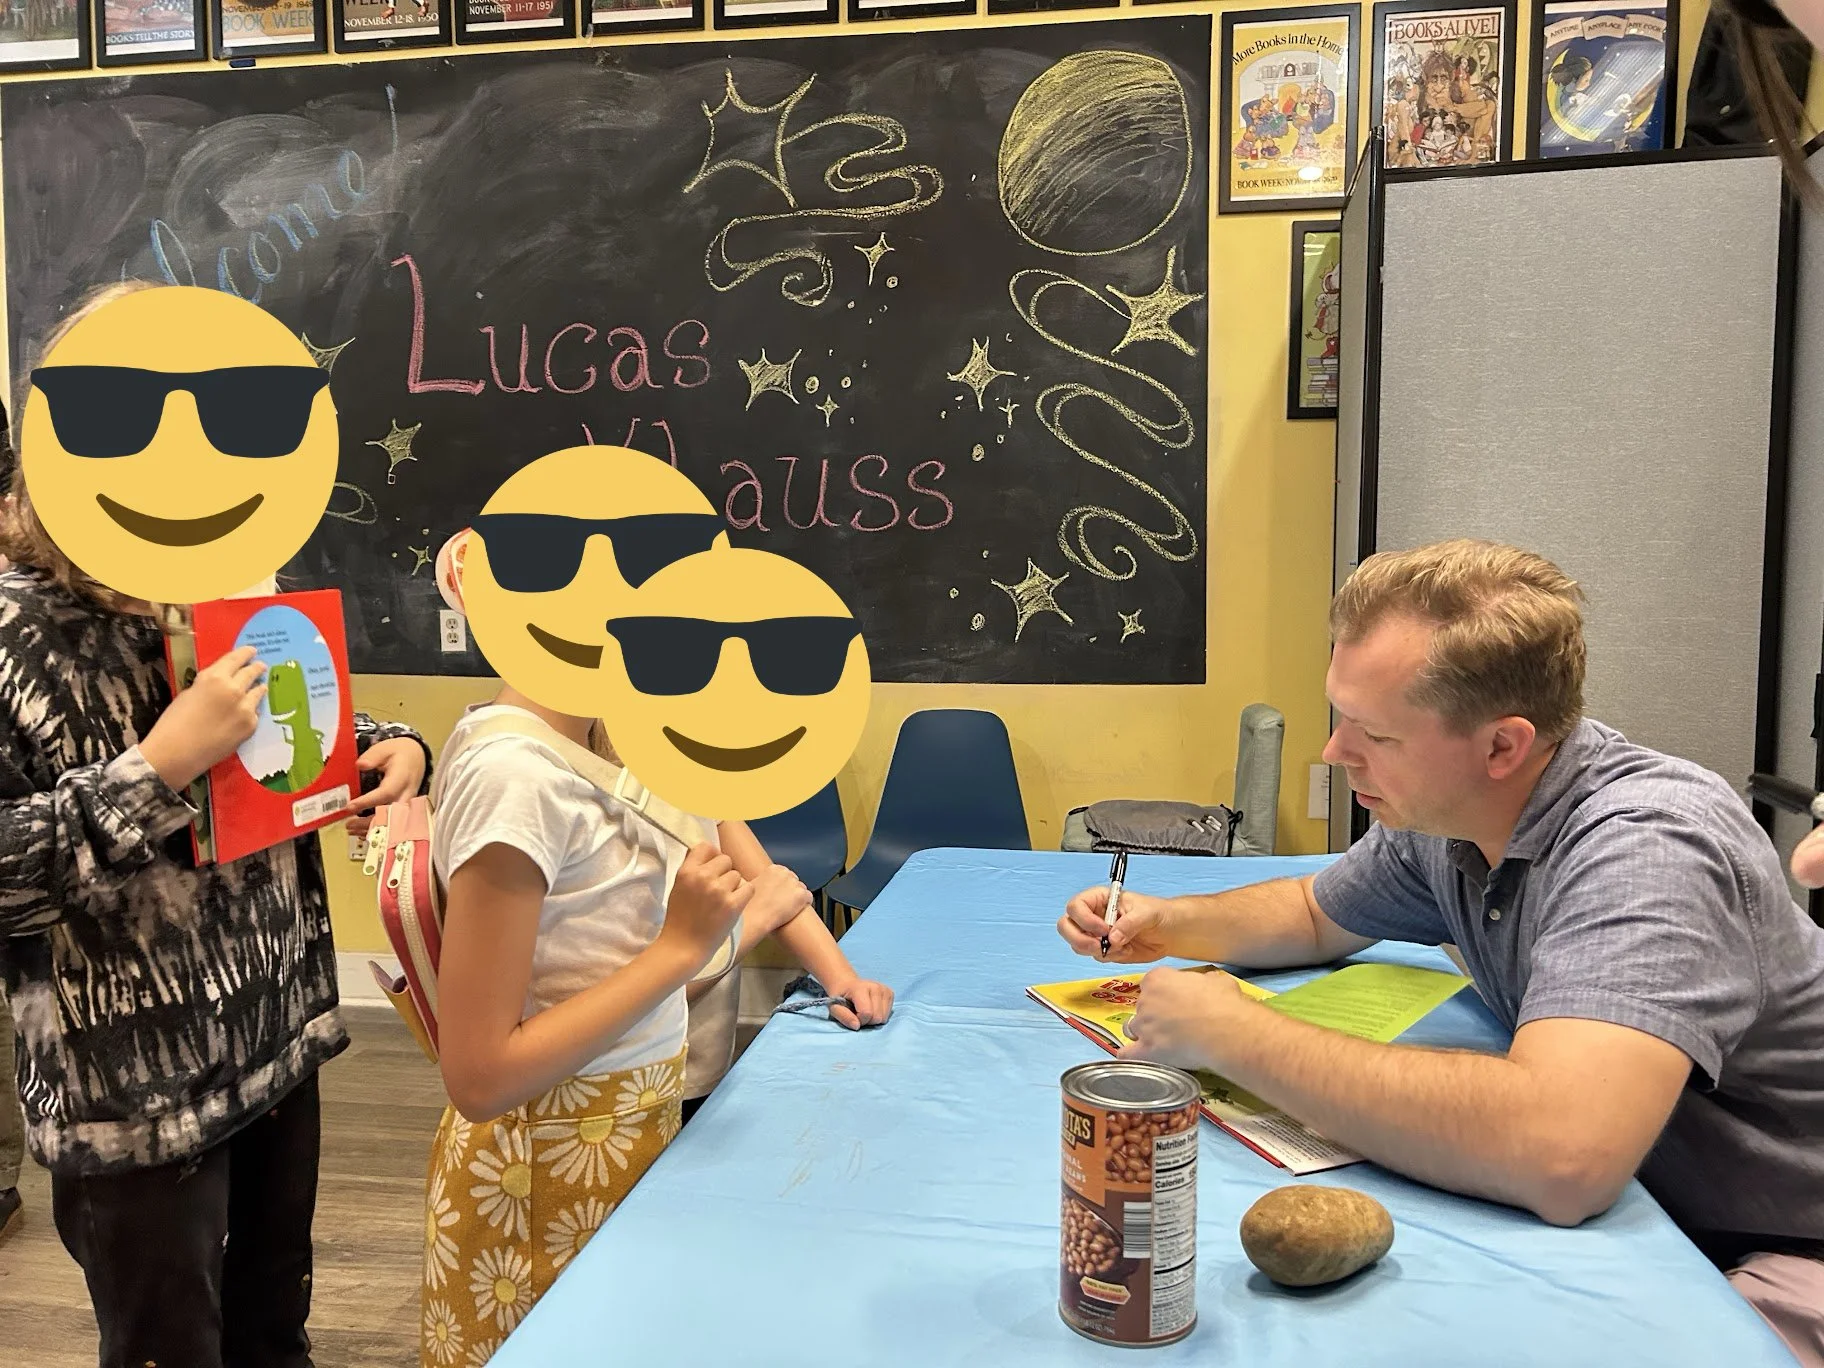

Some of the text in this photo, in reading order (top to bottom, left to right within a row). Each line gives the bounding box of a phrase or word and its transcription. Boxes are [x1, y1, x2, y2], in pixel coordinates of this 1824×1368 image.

[469, 1, 554, 15] NOVEMBER 11-17 1951
[222, 10, 314, 32] BOOK WEEK
[344, 16, 392, 28] NOVEMBER
[106, 29, 195, 44] BOOKS TELL THE STORY
[1232, 33, 1344, 65] More Books in the Home
[1237, 179, 1260, 189] BOOK
[390, 252, 712, 395] Lucas
[1156, 1138, 1186, 1151] Nutrition
[1155, 1177, 1184, 1189] Calories
